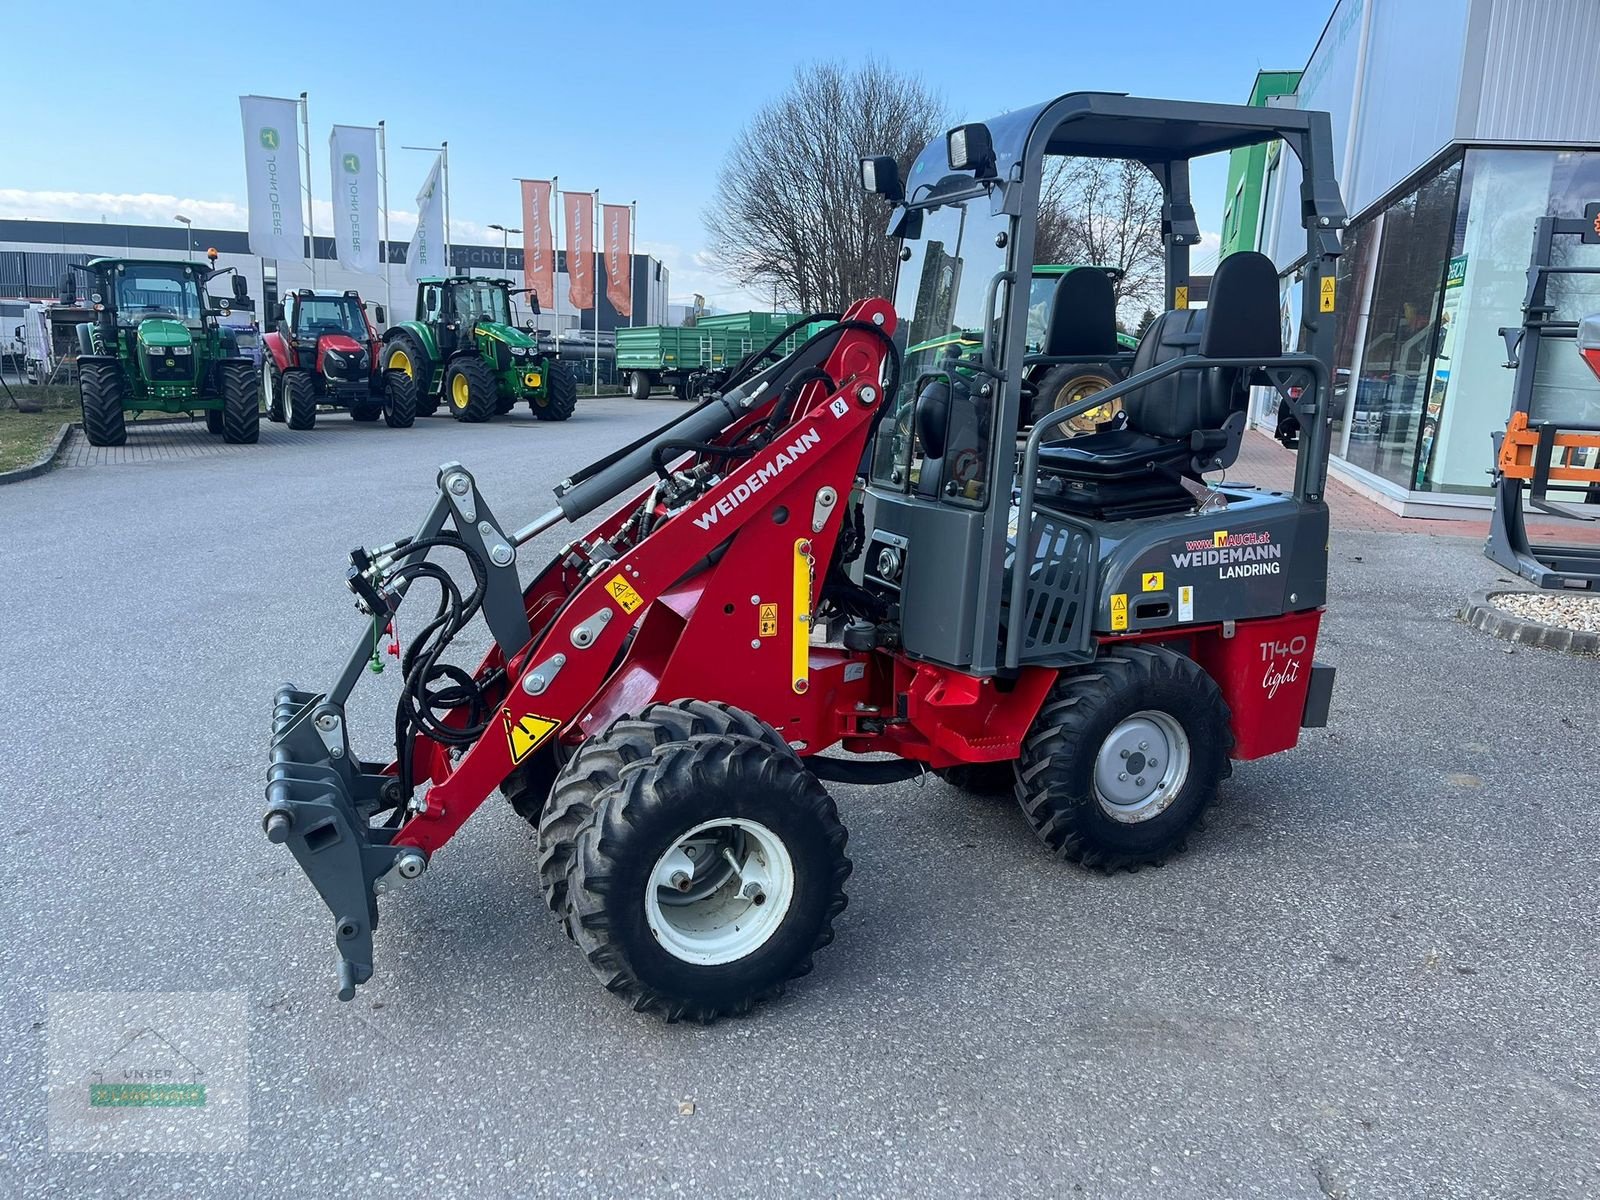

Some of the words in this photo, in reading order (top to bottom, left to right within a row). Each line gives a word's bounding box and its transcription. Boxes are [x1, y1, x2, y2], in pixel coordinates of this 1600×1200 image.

[692, 427, 821, 531] WEIDEMANN
[1185, 531, 1270, 551] www.MAUCH.at
[1171, 543, 1281, 569] WEIDEMANN
[1219, 561, 1280, 580] LANDRING
[1260, 636, 1306, 662] 1140
[1262, 658, 1300, 700] light
